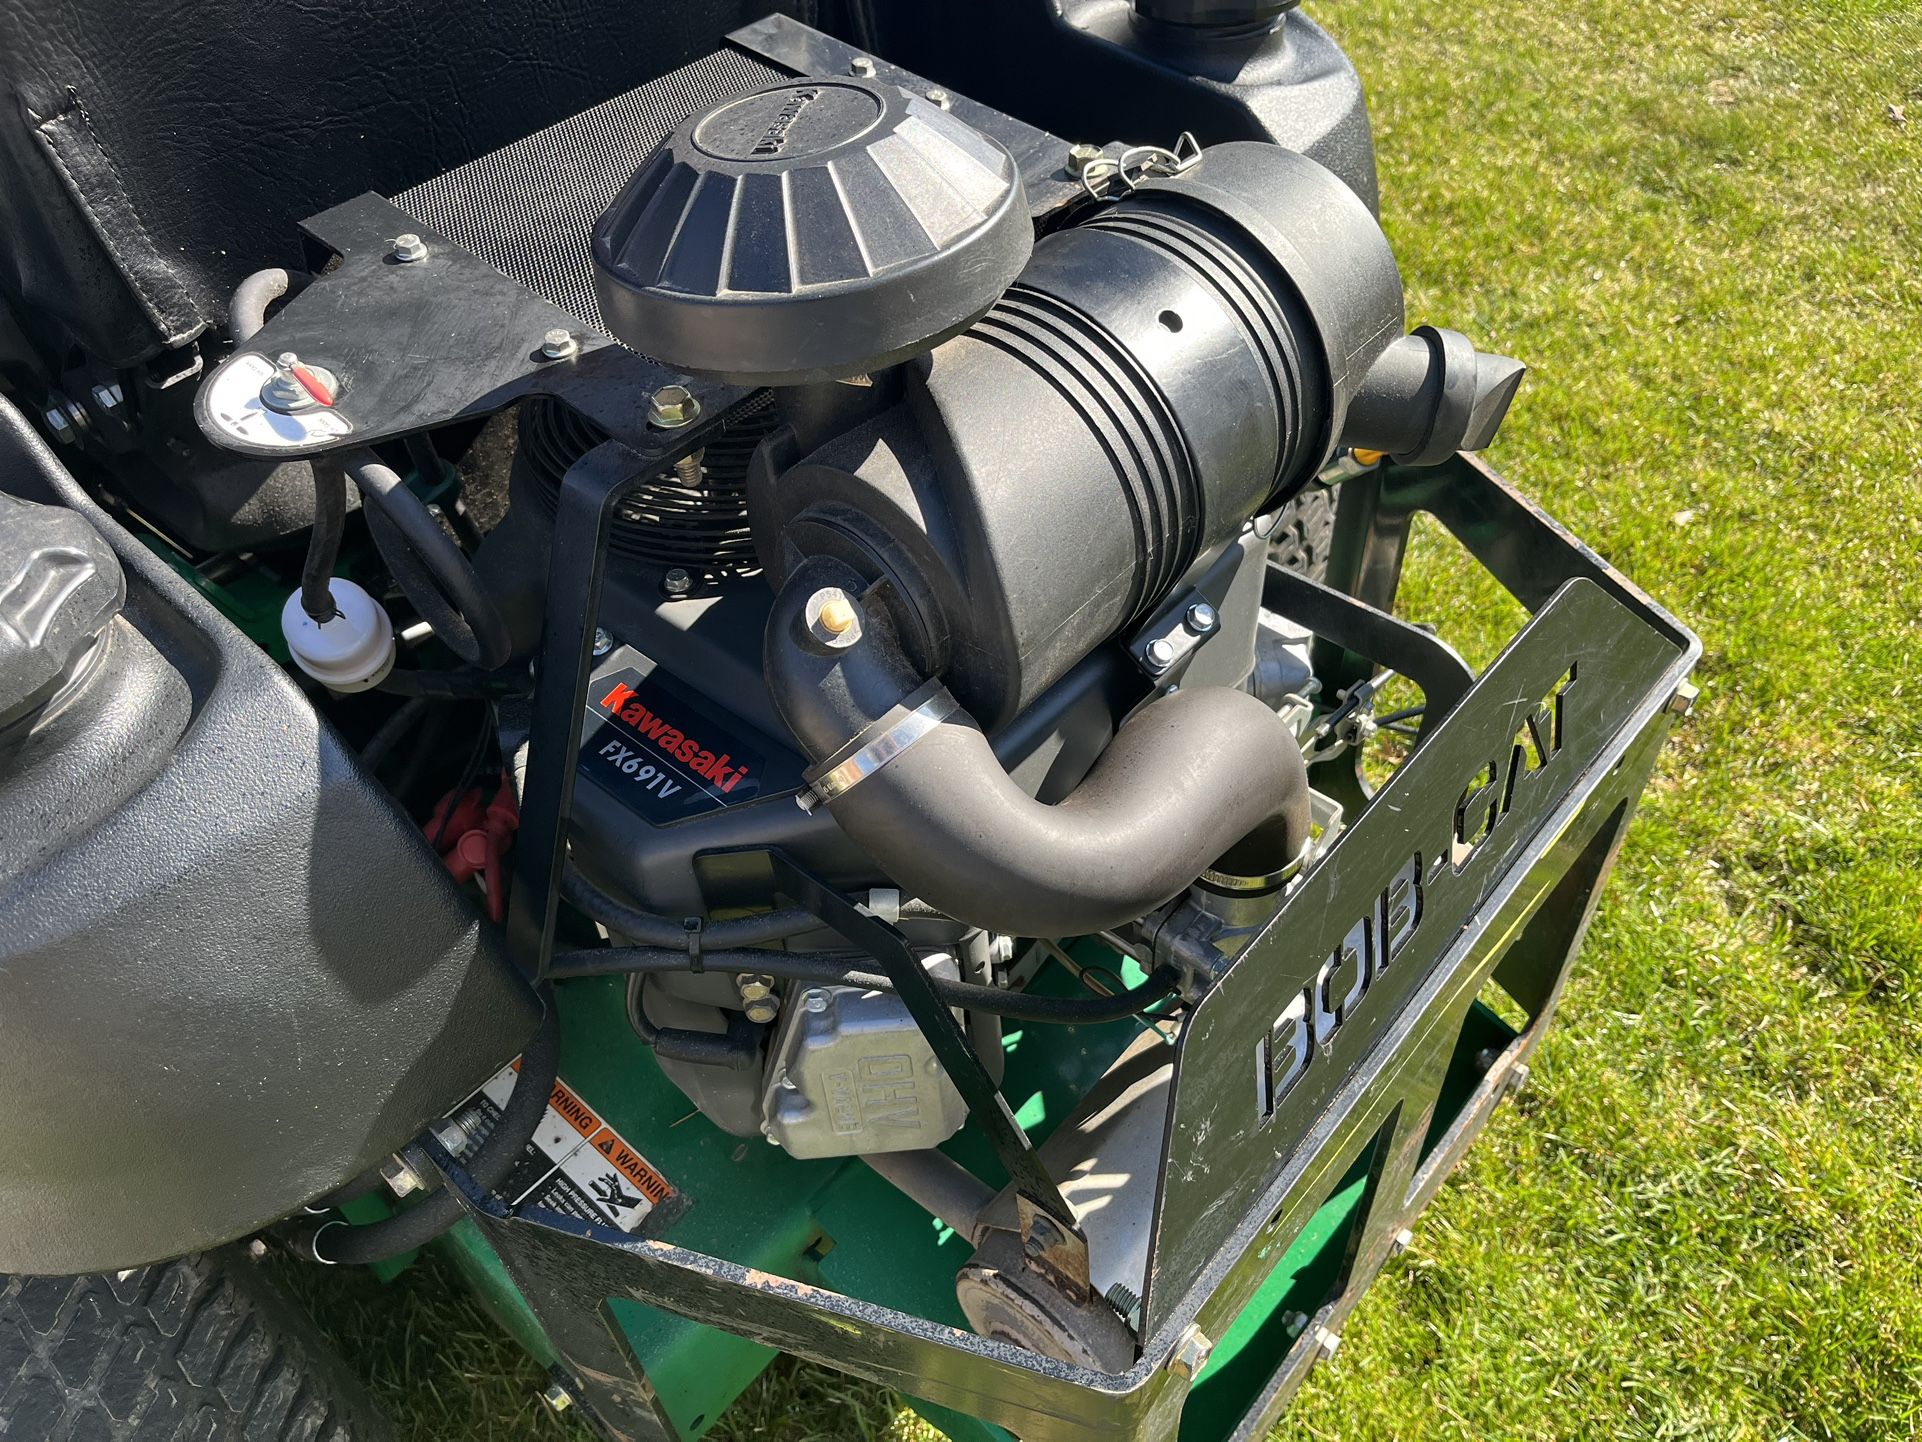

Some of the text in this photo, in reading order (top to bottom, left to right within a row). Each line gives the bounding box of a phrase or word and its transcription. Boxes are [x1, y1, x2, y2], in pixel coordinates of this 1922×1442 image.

[600, 682, 748, 793] Kawasaki
[598, 739, 682, 799] FX691V
[1256, 661, 1578, 1130] BOB-CAT
[549, 1084, 593, 1131] RNING
[857, 1054, 921, 1129] OHV
[556, 1177, 572, 1193] HIGH
[568, 1190, 598, 1220] PRESSURE
[614, 1149, 673, 1203] WARNIN
